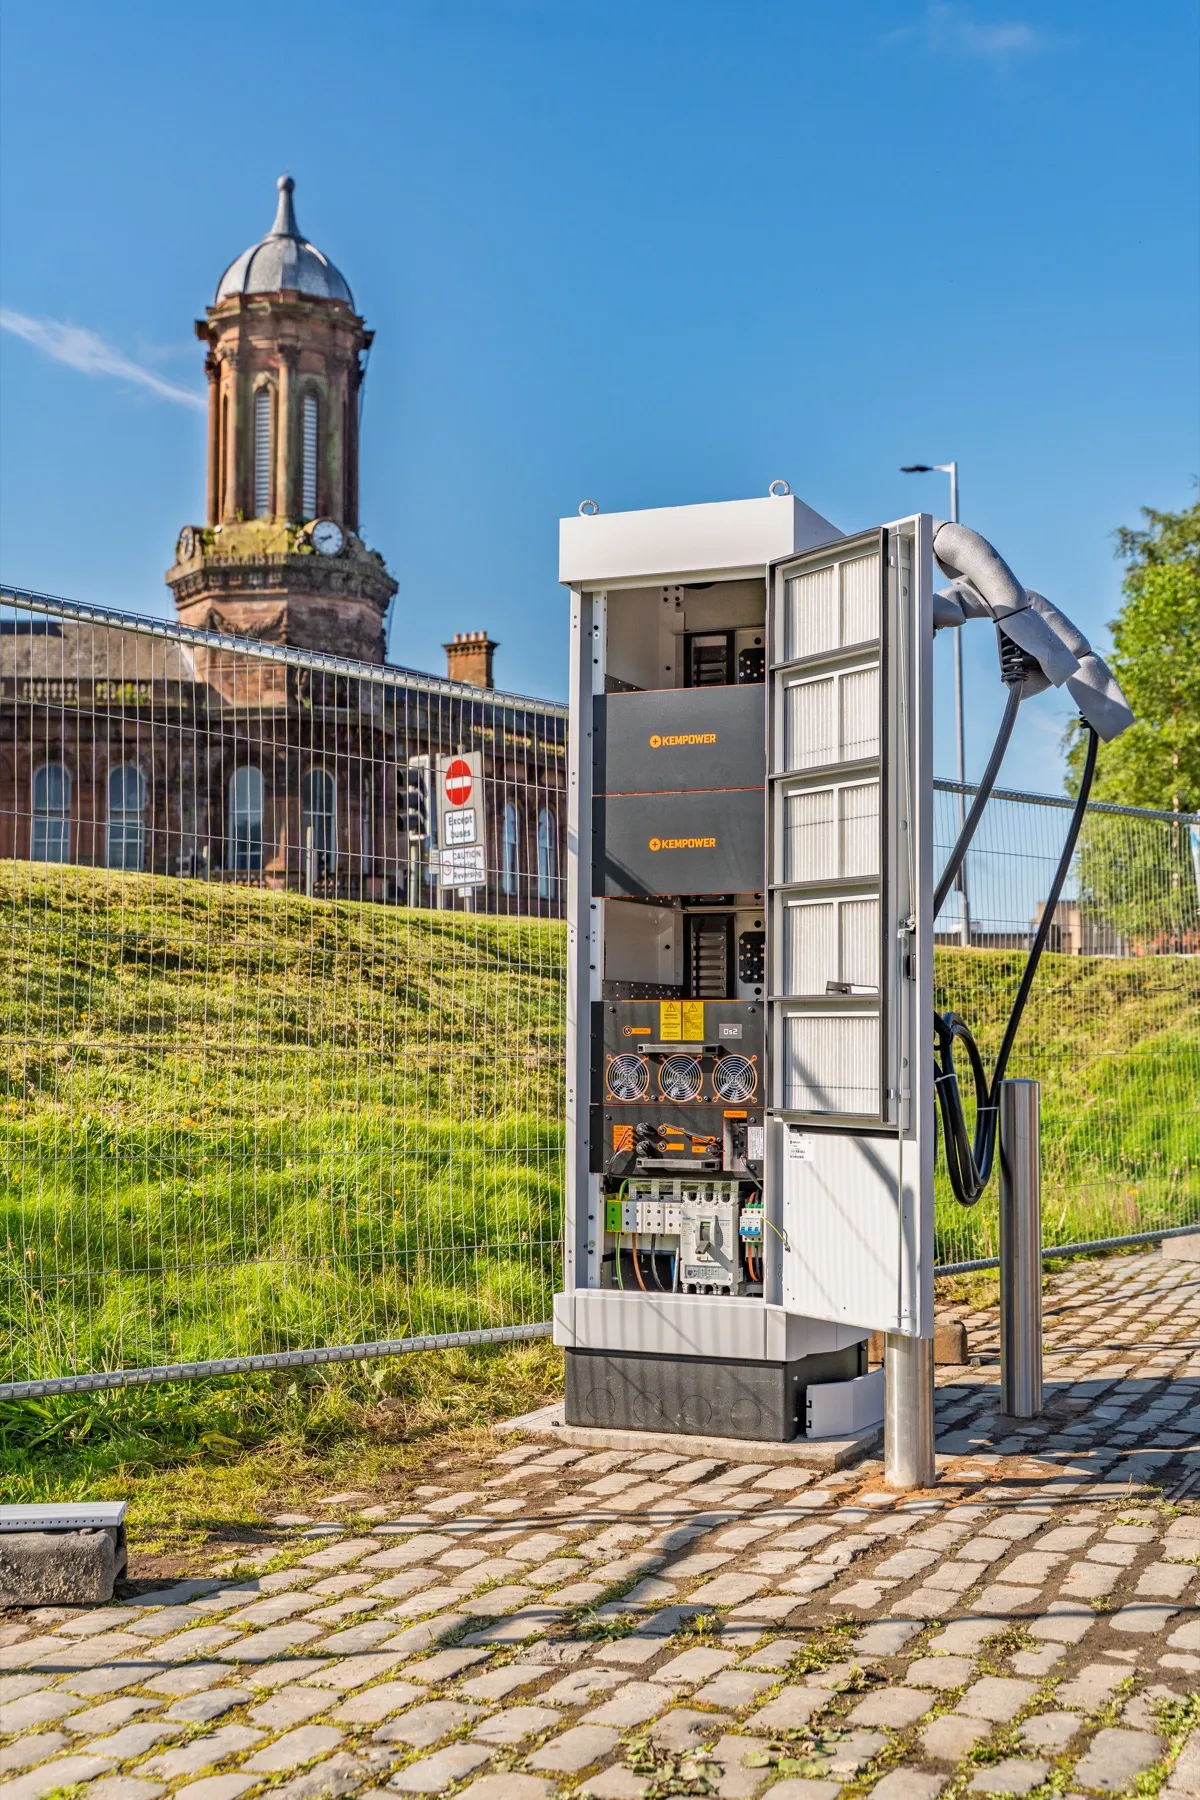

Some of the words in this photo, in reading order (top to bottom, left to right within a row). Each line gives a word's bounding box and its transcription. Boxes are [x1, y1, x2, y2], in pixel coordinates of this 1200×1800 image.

[662, 733, 716, 746] KEMPOWER
[448, 814, 473, 826] Except
[662, 838, 716, 849] KEMPOWER
[453, 850, 482, 860] CAUTION
